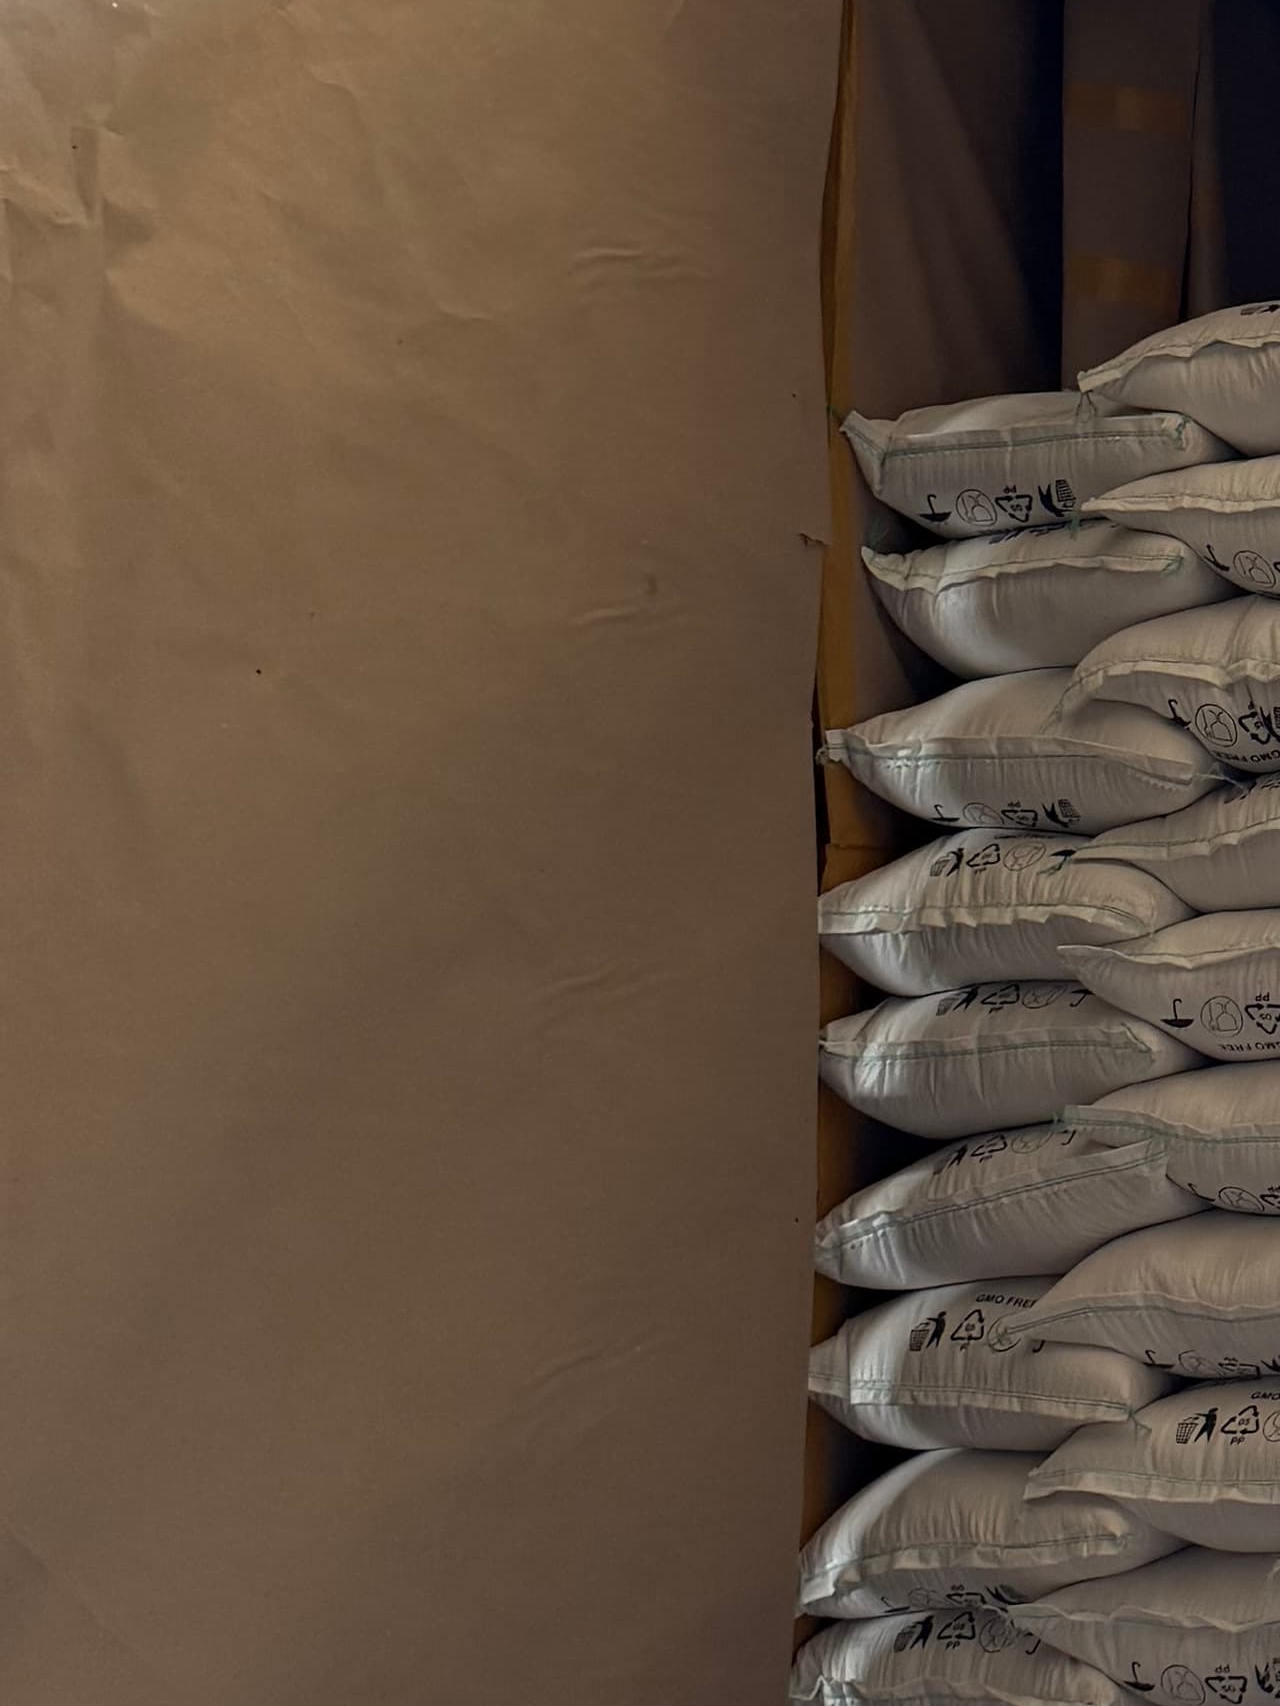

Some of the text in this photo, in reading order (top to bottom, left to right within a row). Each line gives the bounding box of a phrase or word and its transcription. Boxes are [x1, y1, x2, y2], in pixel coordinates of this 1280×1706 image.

[1255, 993, 1270, 1002] PP
[1259, 1012, 1271, 1020] 05
[976, 1294, 1007, 1304] GMO
[1252, 1392, 1280, 1401] GMO
[1215, 1665, 1230, 1673] PP
